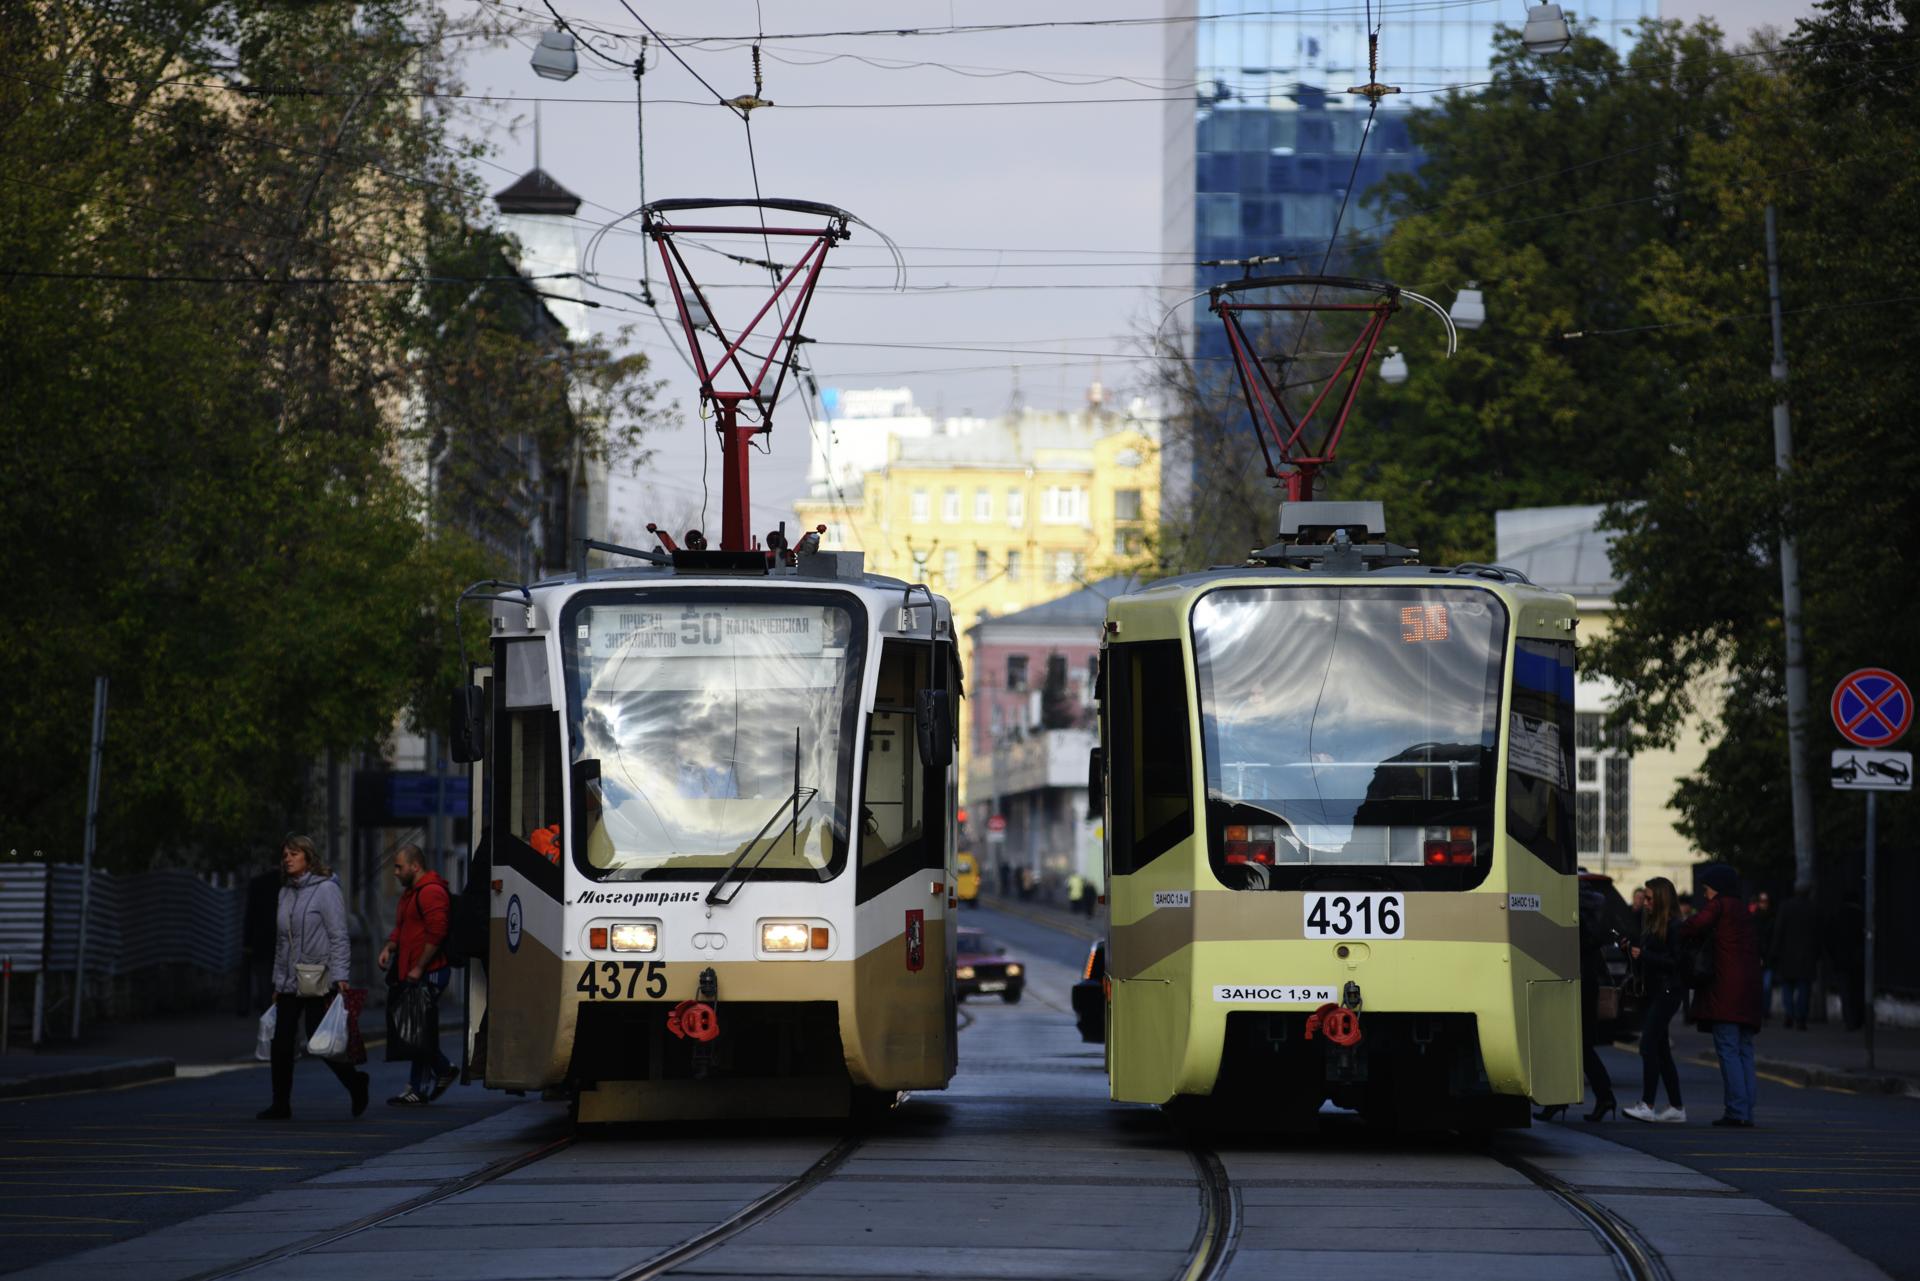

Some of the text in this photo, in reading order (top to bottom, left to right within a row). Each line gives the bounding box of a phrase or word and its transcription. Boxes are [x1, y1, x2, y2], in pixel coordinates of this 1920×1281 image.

[619, 613, 663, 630] ПРОЕЗД
[681, 611, 722, 645] 50
[1402, 605, 1448, 642] 50
[577, 890, 700, 906] Мосгортранс
[1155, 893, 1175, 905] ЗАНОС
[1511, 896, 1528, 908] ЗАНОС
[1306, 896, 1401, 935] 4316
[576, 961, 668, 1000] 4375
[1221, 988, 1329, 1001] ЗАНОС 1,9 м
